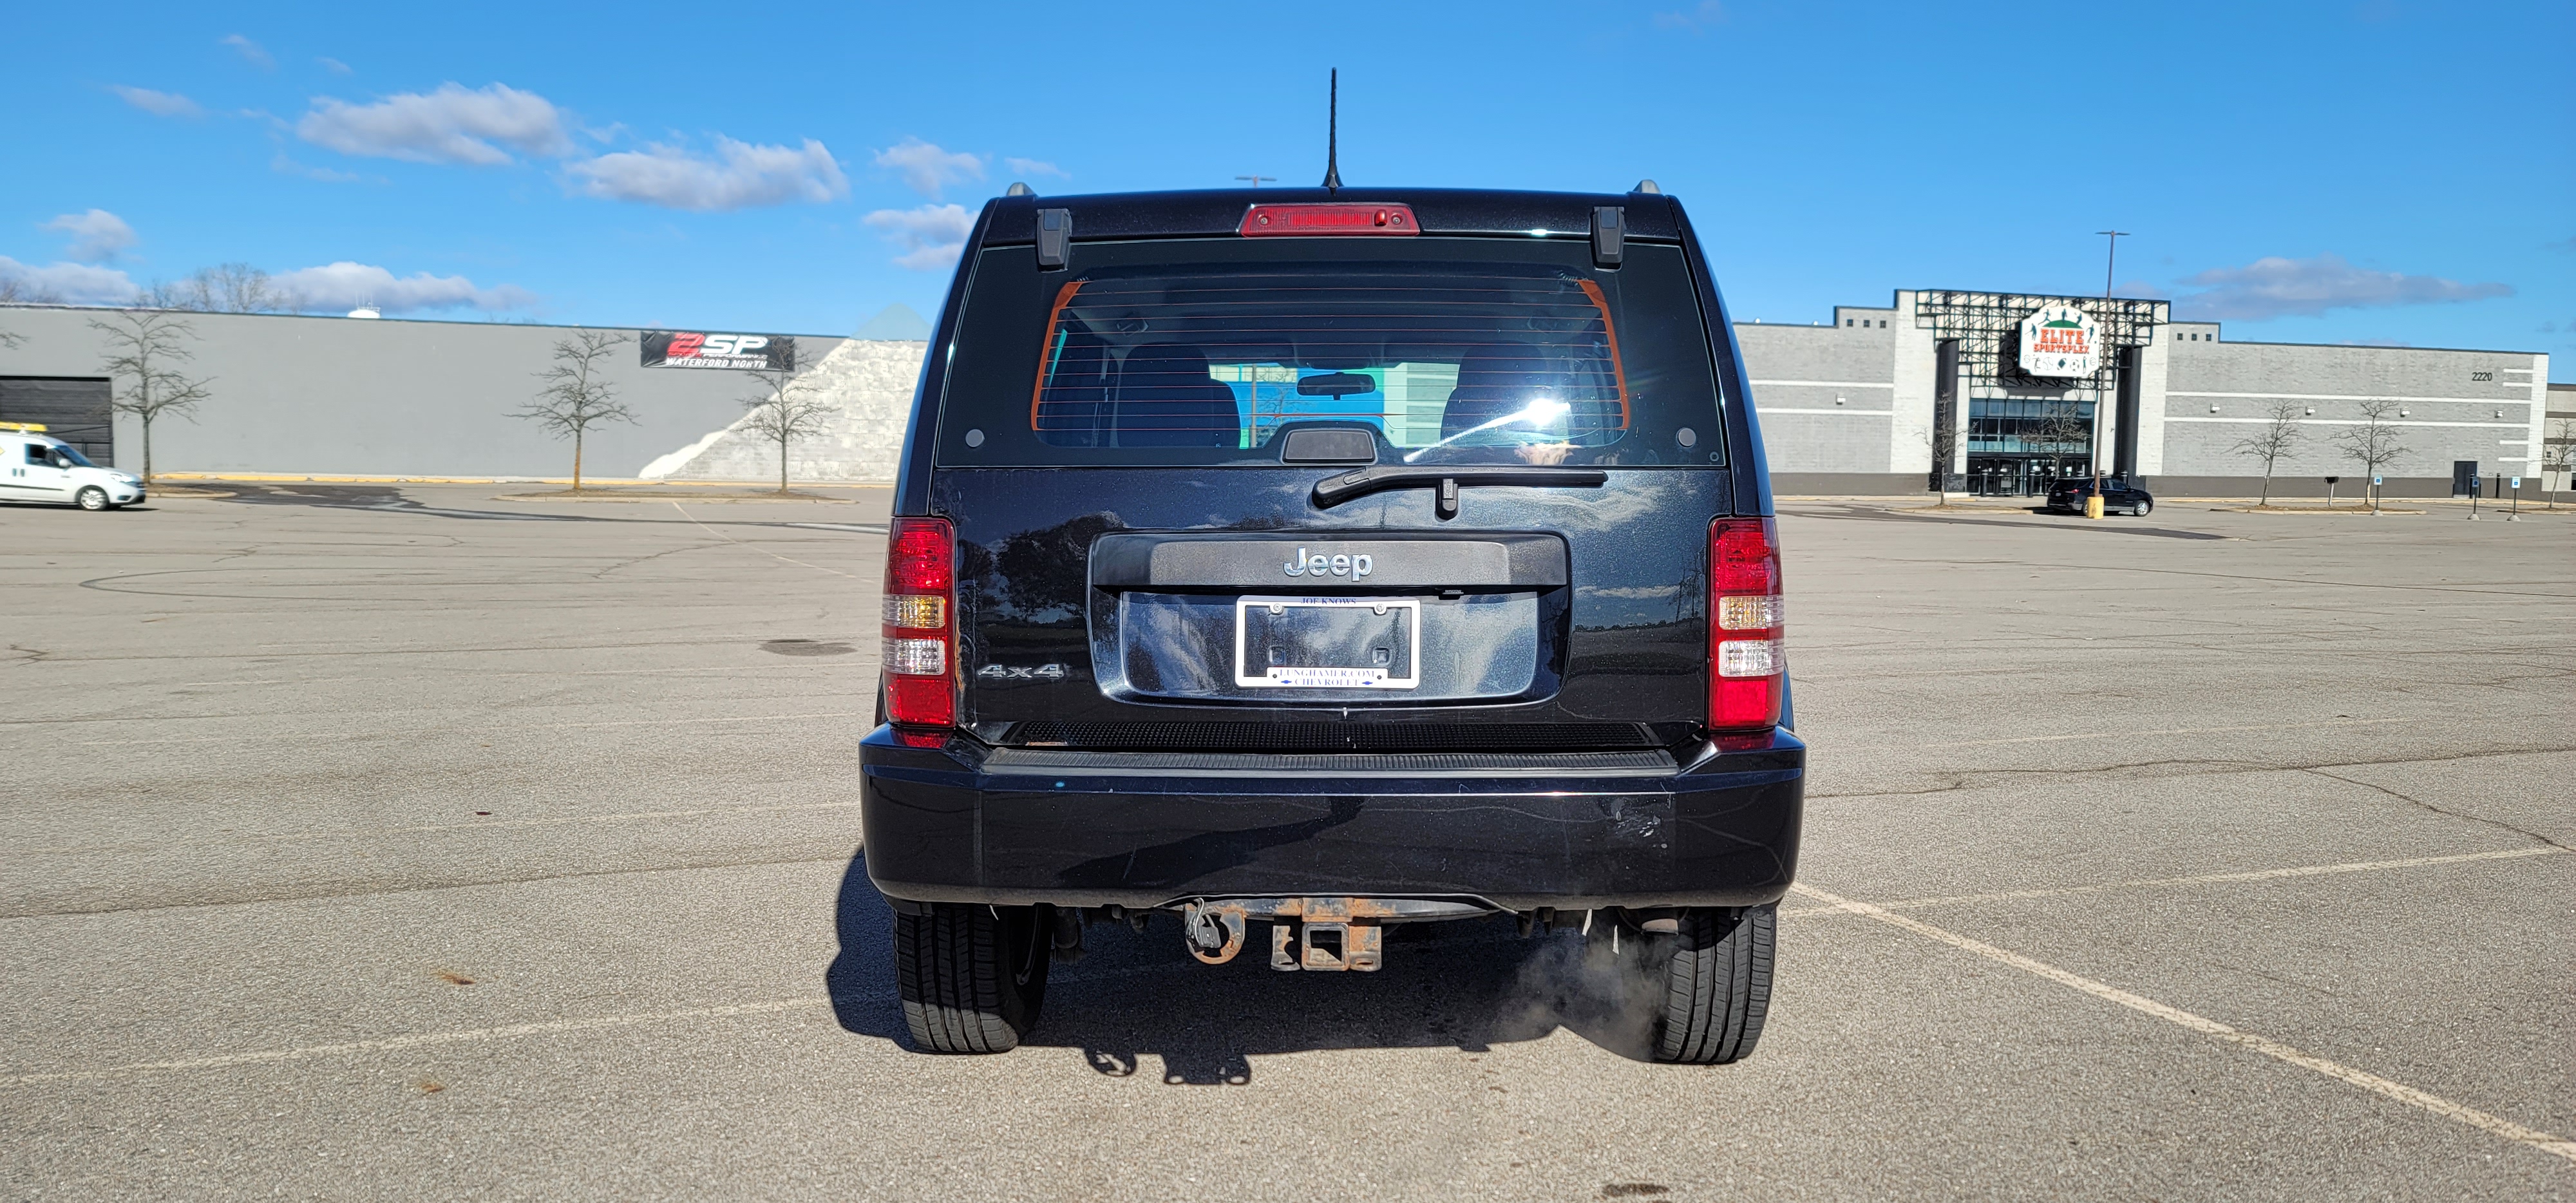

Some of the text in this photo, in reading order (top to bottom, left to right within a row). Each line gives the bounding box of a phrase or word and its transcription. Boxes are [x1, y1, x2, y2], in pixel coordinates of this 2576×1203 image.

[2040, 328, 2085, 345] ELITE
[2033, 343, 2090, 354] SPORTSPLEX
[666, 357, 768, 368] WATERFORD NORTH
[2472, 372, 2492, 381] 2220
[1283, 546, 1373, 582] Jeep
[978, 664, 1064, 678] 4x4
